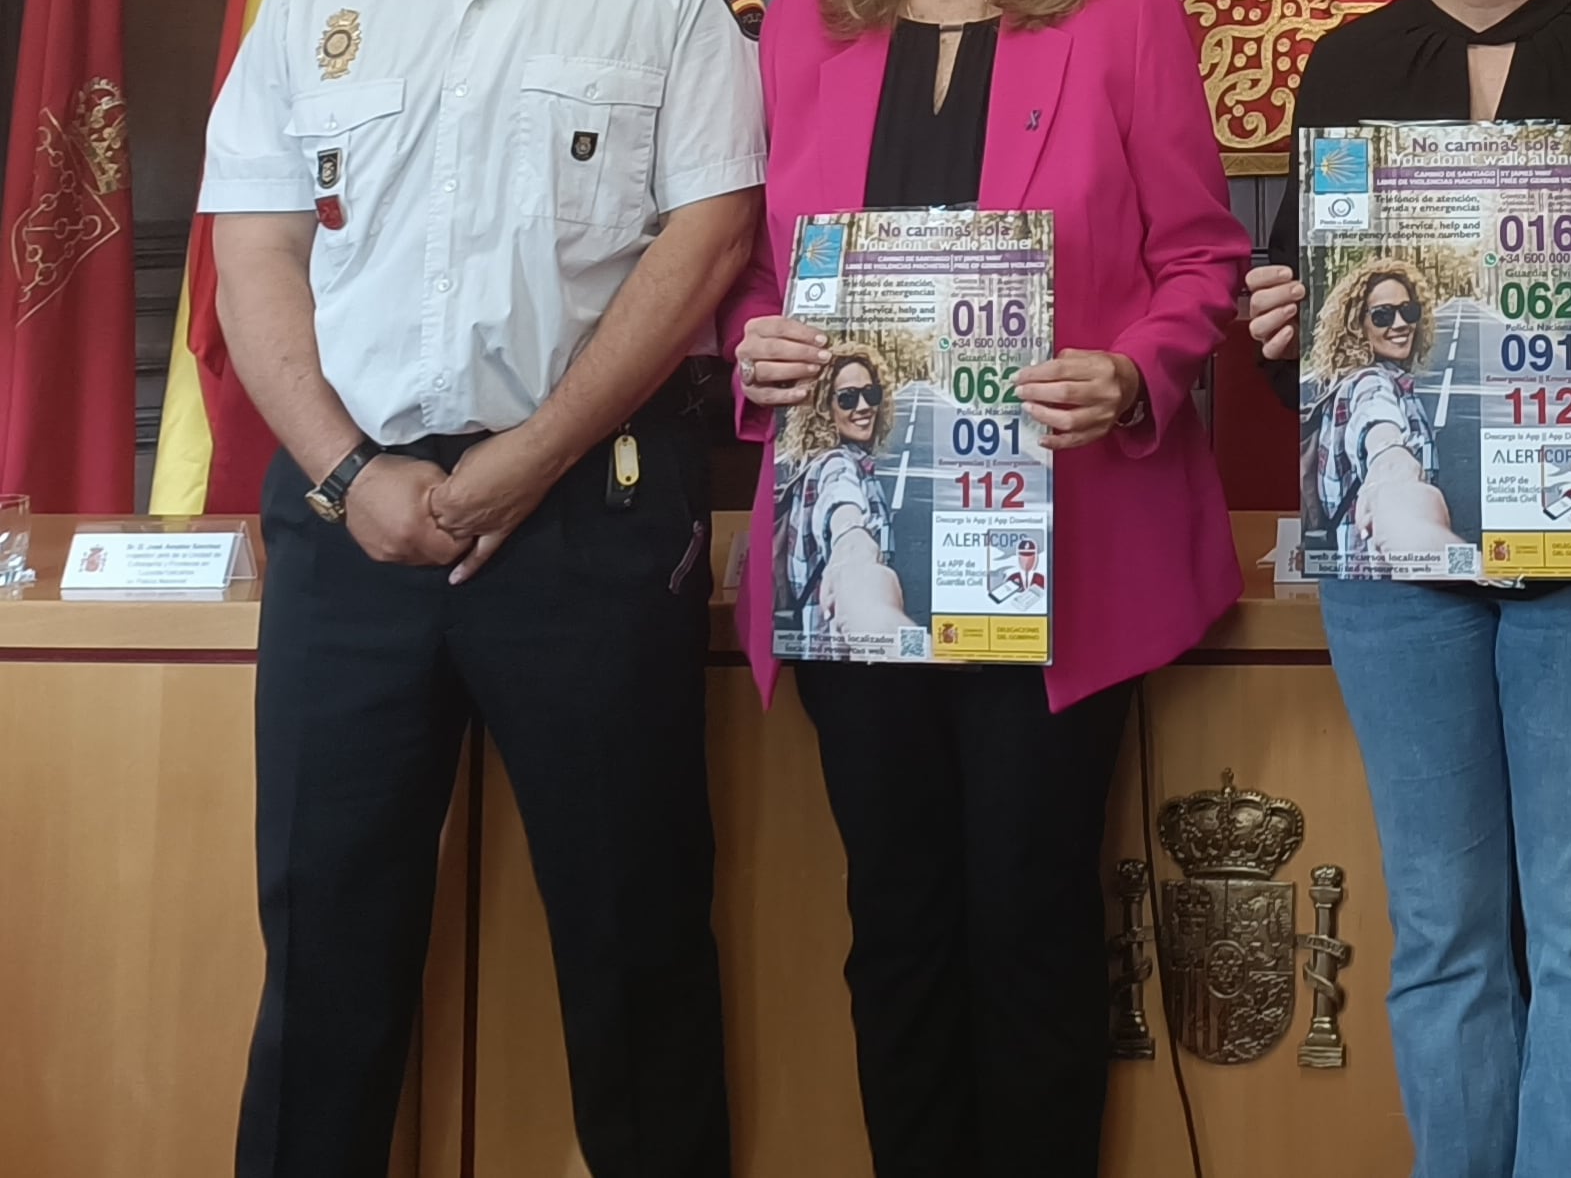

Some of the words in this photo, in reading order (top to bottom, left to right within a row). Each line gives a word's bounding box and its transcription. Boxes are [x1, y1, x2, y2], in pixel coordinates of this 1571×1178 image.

[1412, 138, 1438, 153] No
[1445, 138, 1518, 153] caminas
[1524, 137, 1561, 152] sola
[1391, 153, 1425, 167] You
[1484, 153, 1526, 166] walk
[1412, 206, 1417, 214] y
[1419, 204, 1480, 213] emergencias
[878, 223, 901, 237] No
[906, 223, 970, 237] caminas
[1439, 221, 1460, 232] help
[1437, 230, 1480, 238] numbers
[939, 237, 978, 251] walk
[1499, 253, 1520, 263] +34
[1524, 253, 1545, 263] 600
[1549, 253, 1570, 262] 000
[1505, 268, 1548, 277] Guardia
[953, 300, 1026, 337] 016
[953, 366, 1024, 404] 062
[953, 418, 1019, 456] 091
[1525, 433, 1540, 441] App
[1548, 433, 1562, 441] App
[954, 471, 1025, 509] 112
[1486, 494, 1518, 503] Guardia
[1520, 494, 1538, 503] Civil
[1389, 553, 1441, 562] localizados
